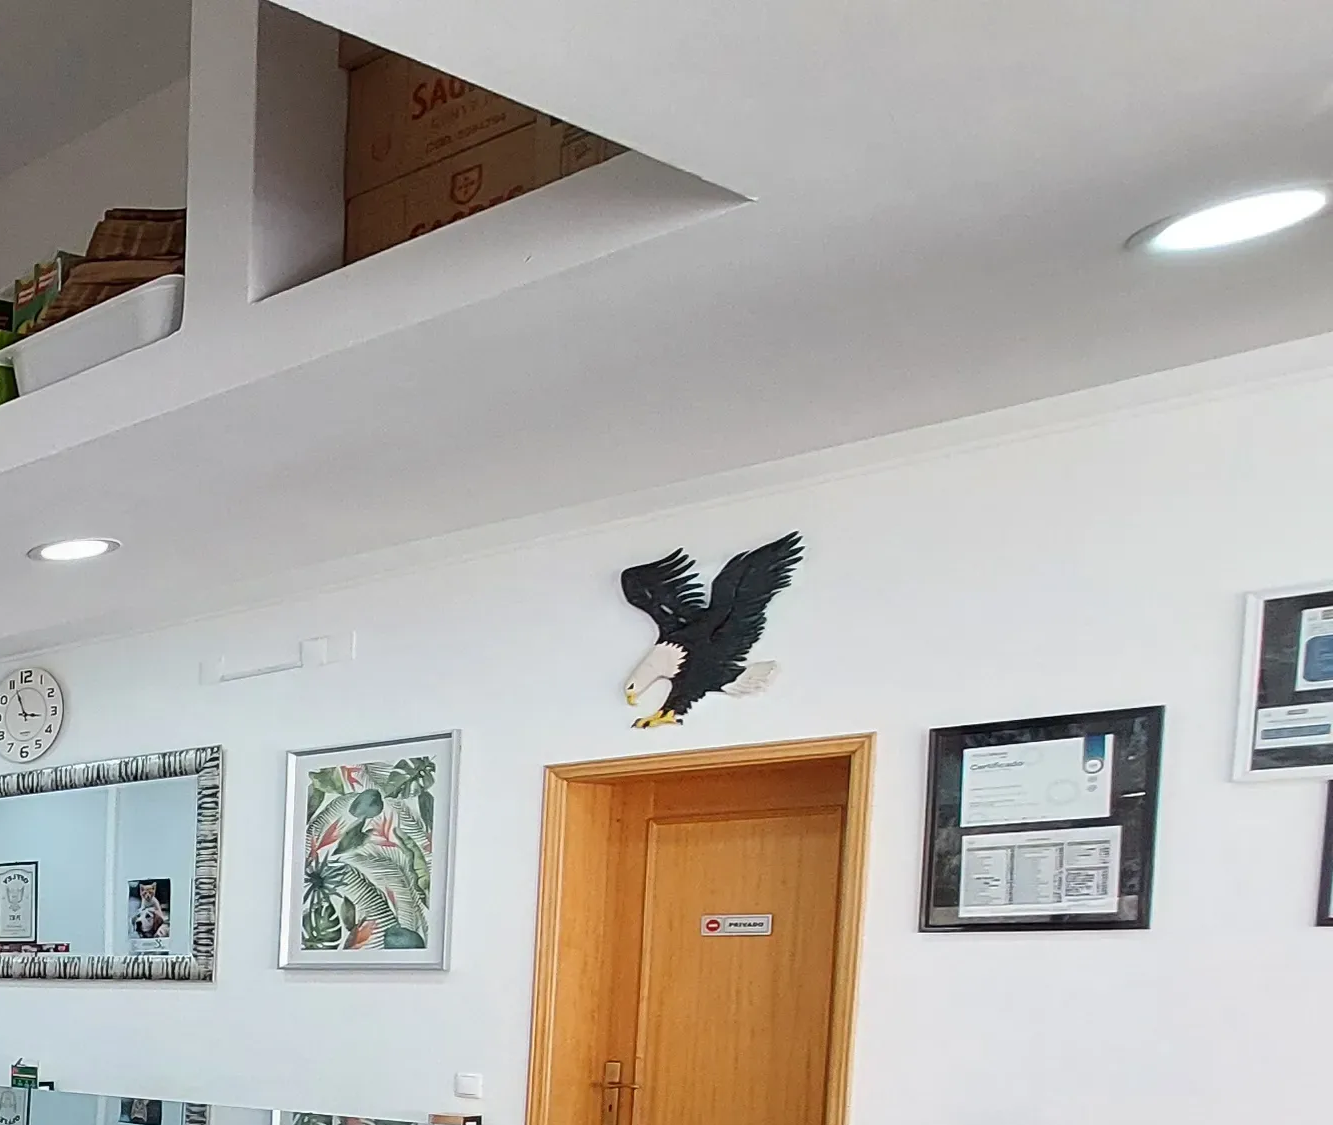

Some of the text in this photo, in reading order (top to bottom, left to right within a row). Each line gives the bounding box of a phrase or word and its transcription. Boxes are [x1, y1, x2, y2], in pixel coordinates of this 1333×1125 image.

[20, 670, 33, 684] 12
[9, 680, 15, 690] 11
[47, 687, 55, 698] 2
[50, 706, 57, 716] 3
[44, 724, 52, 733] 4
[7, 742, 14, 753] 7
[34, 739, 42, 749] 5
[20, 746, 29, 758] 6
[968, 759, 1026, 771] Certificado
[728, 920, 764, 928] PRIVADO
